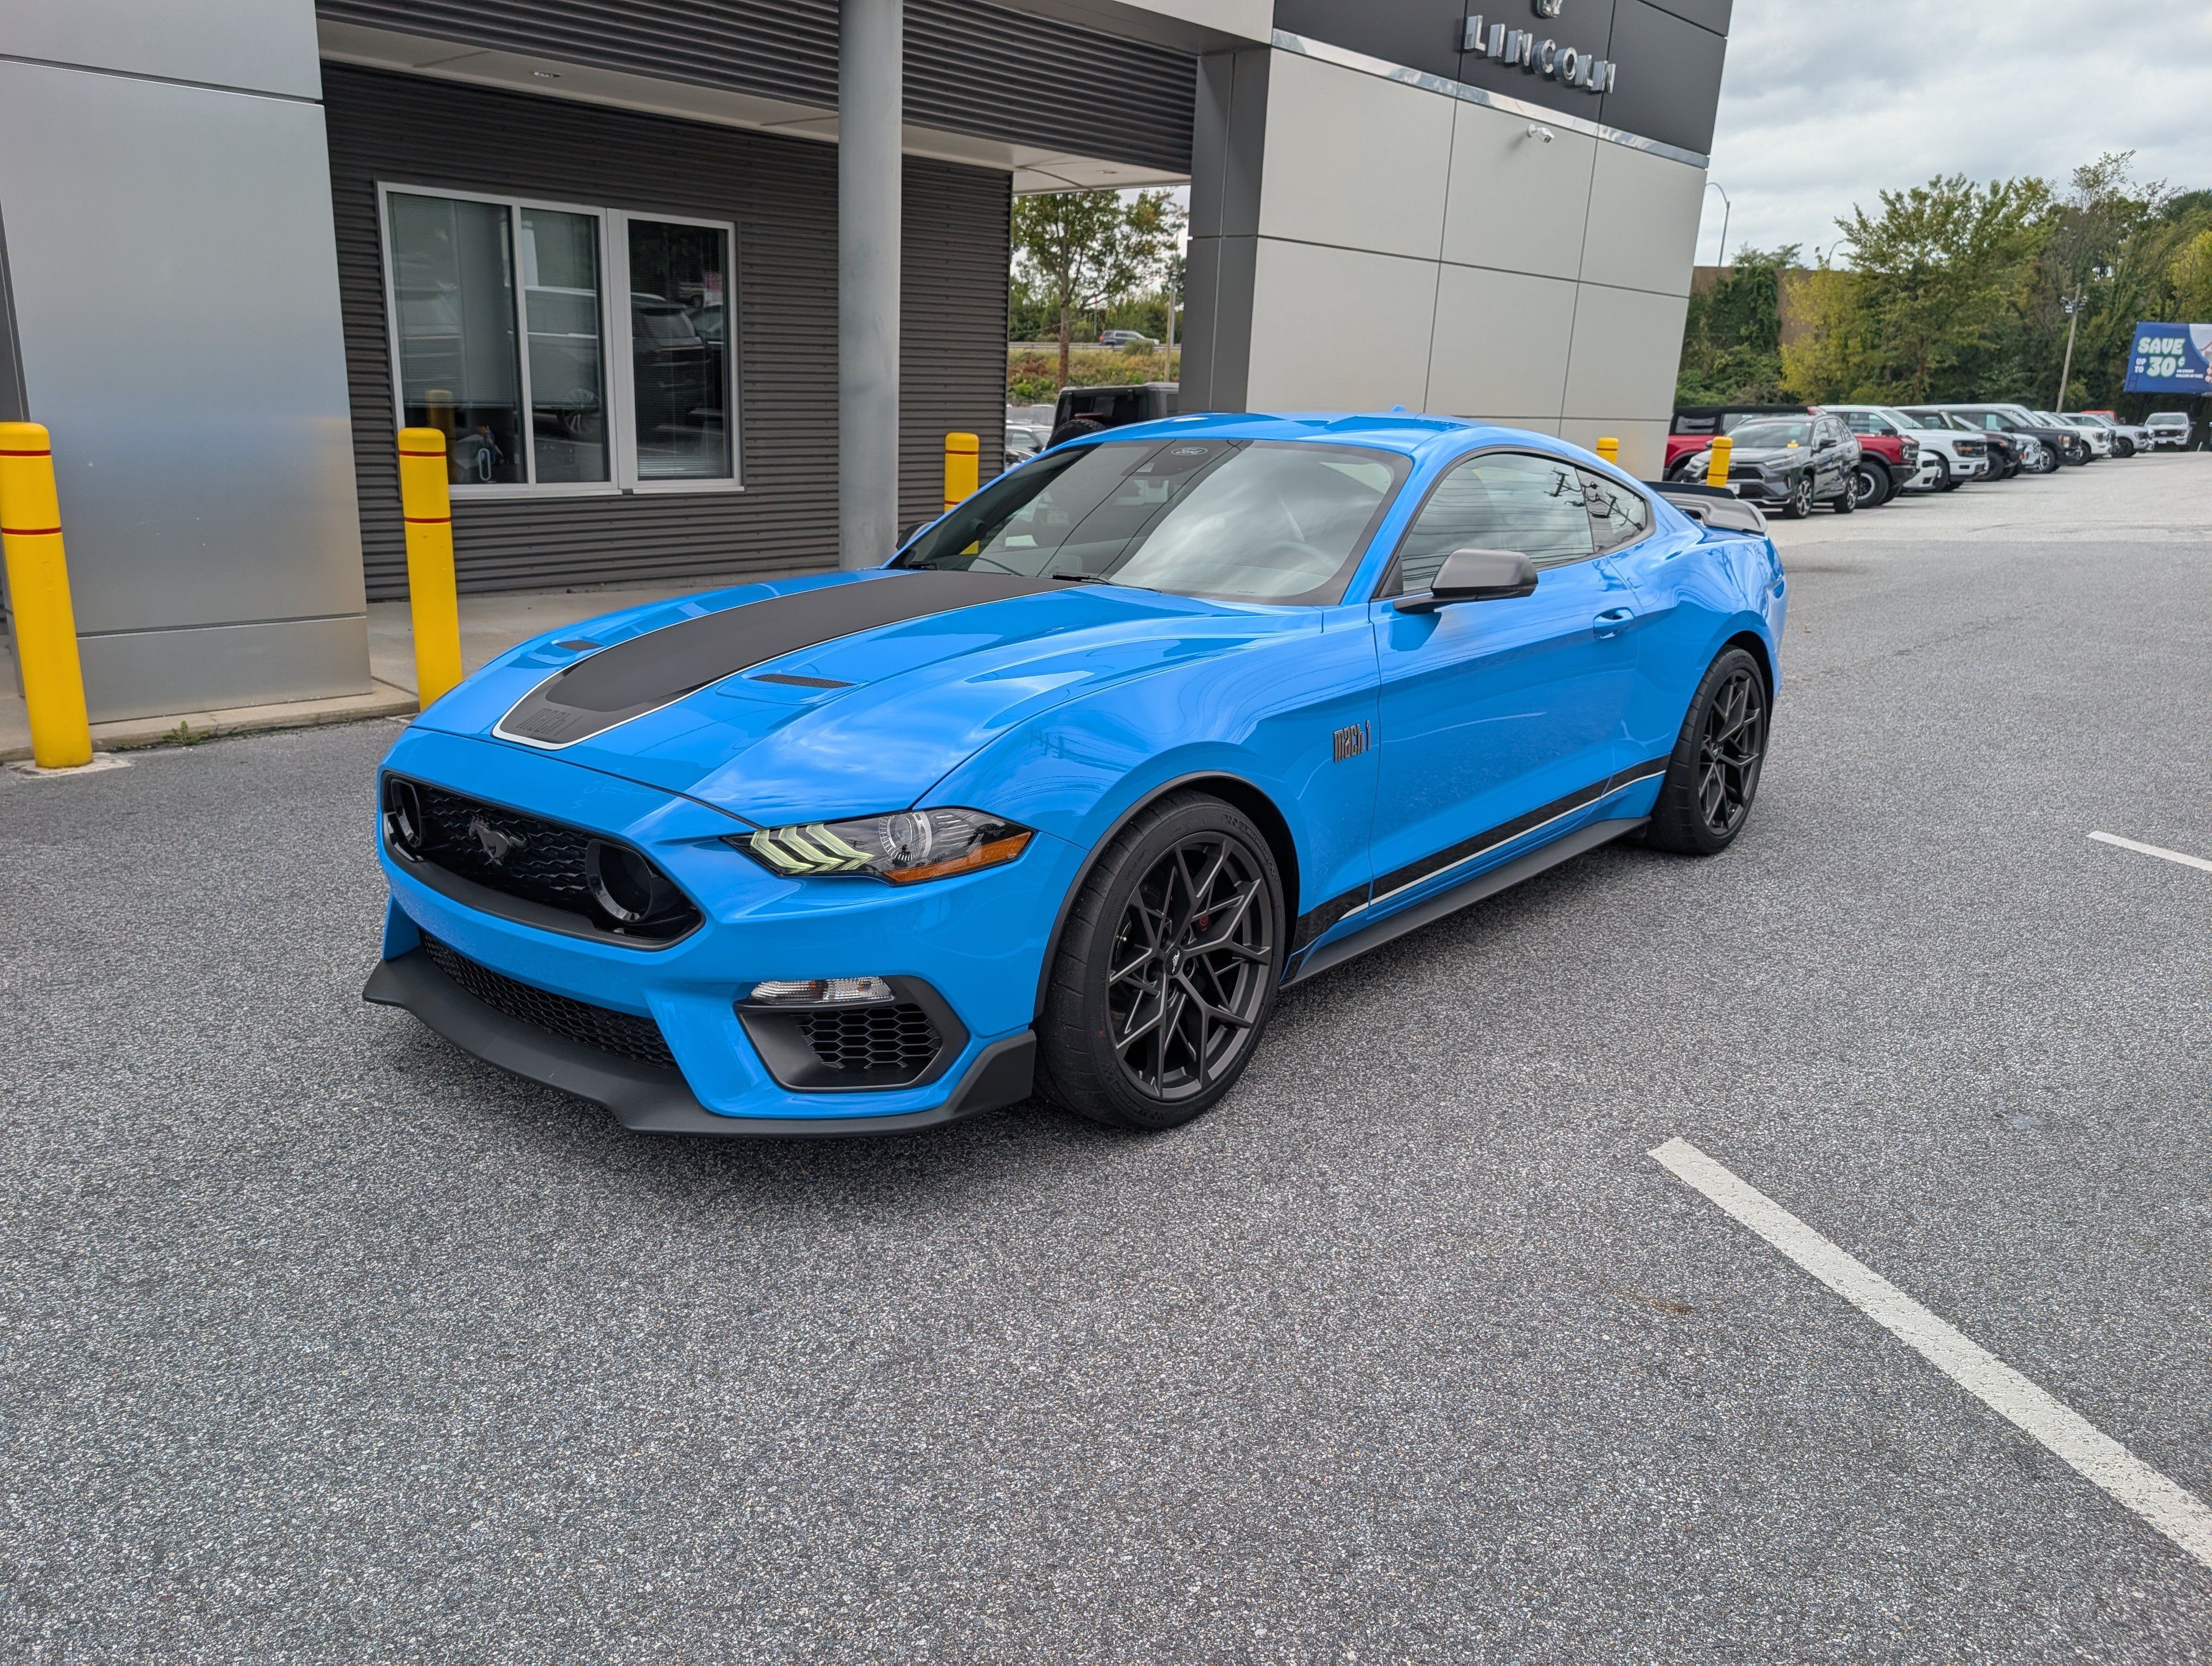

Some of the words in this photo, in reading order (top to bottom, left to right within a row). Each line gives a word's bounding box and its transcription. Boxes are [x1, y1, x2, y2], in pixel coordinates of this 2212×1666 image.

[1464, 15, 1616, 94] LINCOLN
[2138, 337, 2185, 355] SAVE
[2134, 365, 2144, 373] TO
